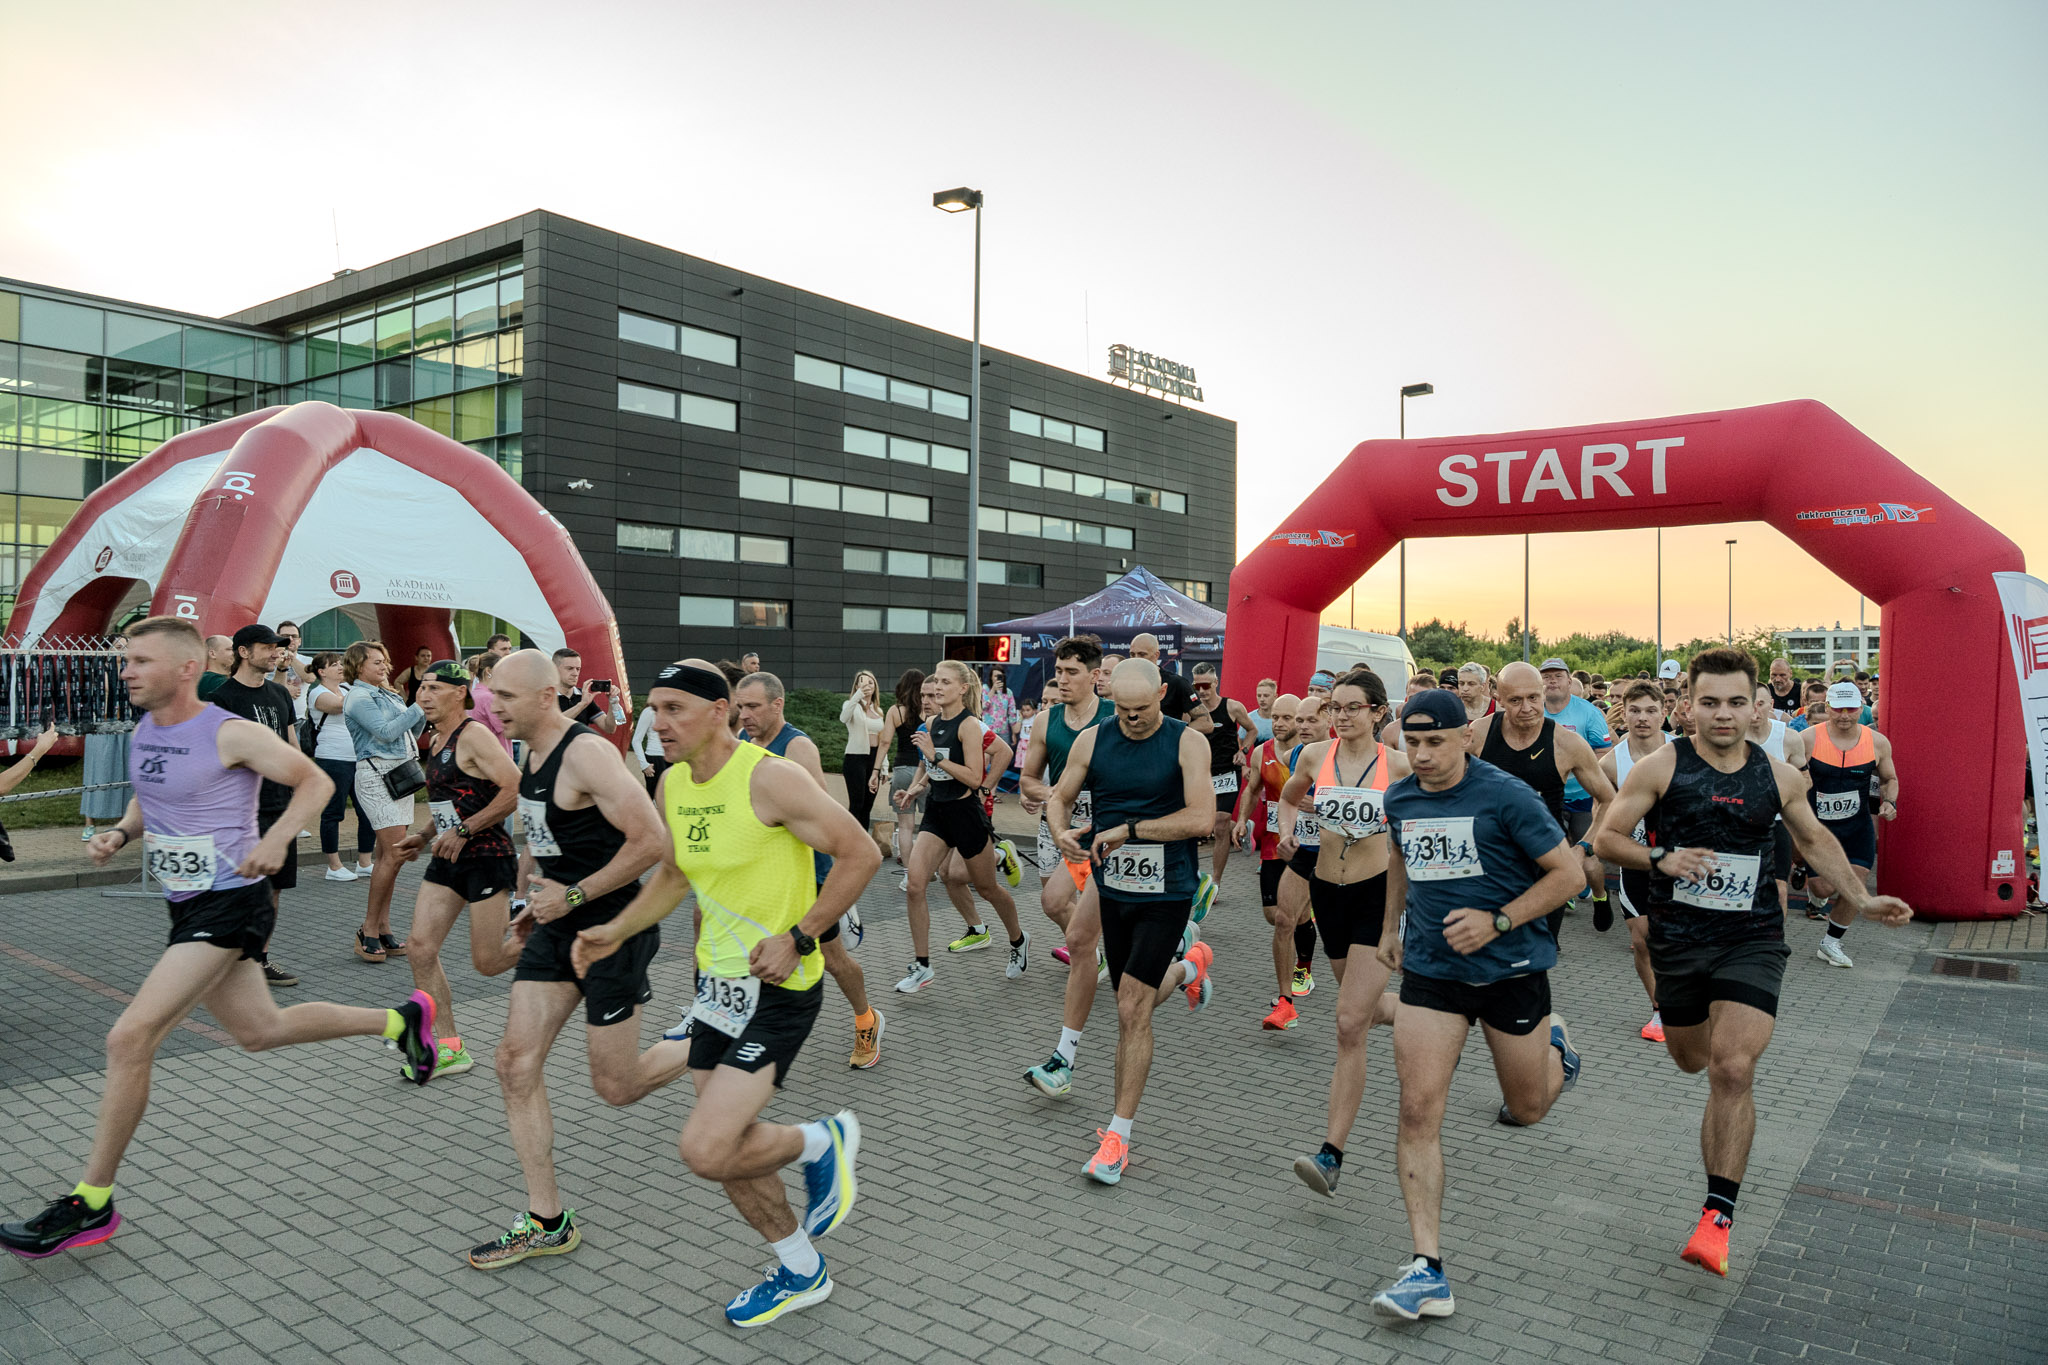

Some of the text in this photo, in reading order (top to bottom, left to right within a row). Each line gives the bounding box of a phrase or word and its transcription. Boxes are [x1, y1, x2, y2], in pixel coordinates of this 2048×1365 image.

[1435, 436, 1686, 507] START
[1797, 507, 1867, 520] elektroniczne
[1833, 512, 1885, 526] zapisy.pl
[388, 578, 446, 592] AKADEMIA
[997, 636, 1010, 662] 2
[1325, 799, 1374, 823] 260
[1824, 799, 1853, 812] 107
[1419, 834, 1449, 861] 31
[158, 848, 201, 874] 253
[1112, 855, 1153, 878] 126
[710, 976, 747, 1014] 133
